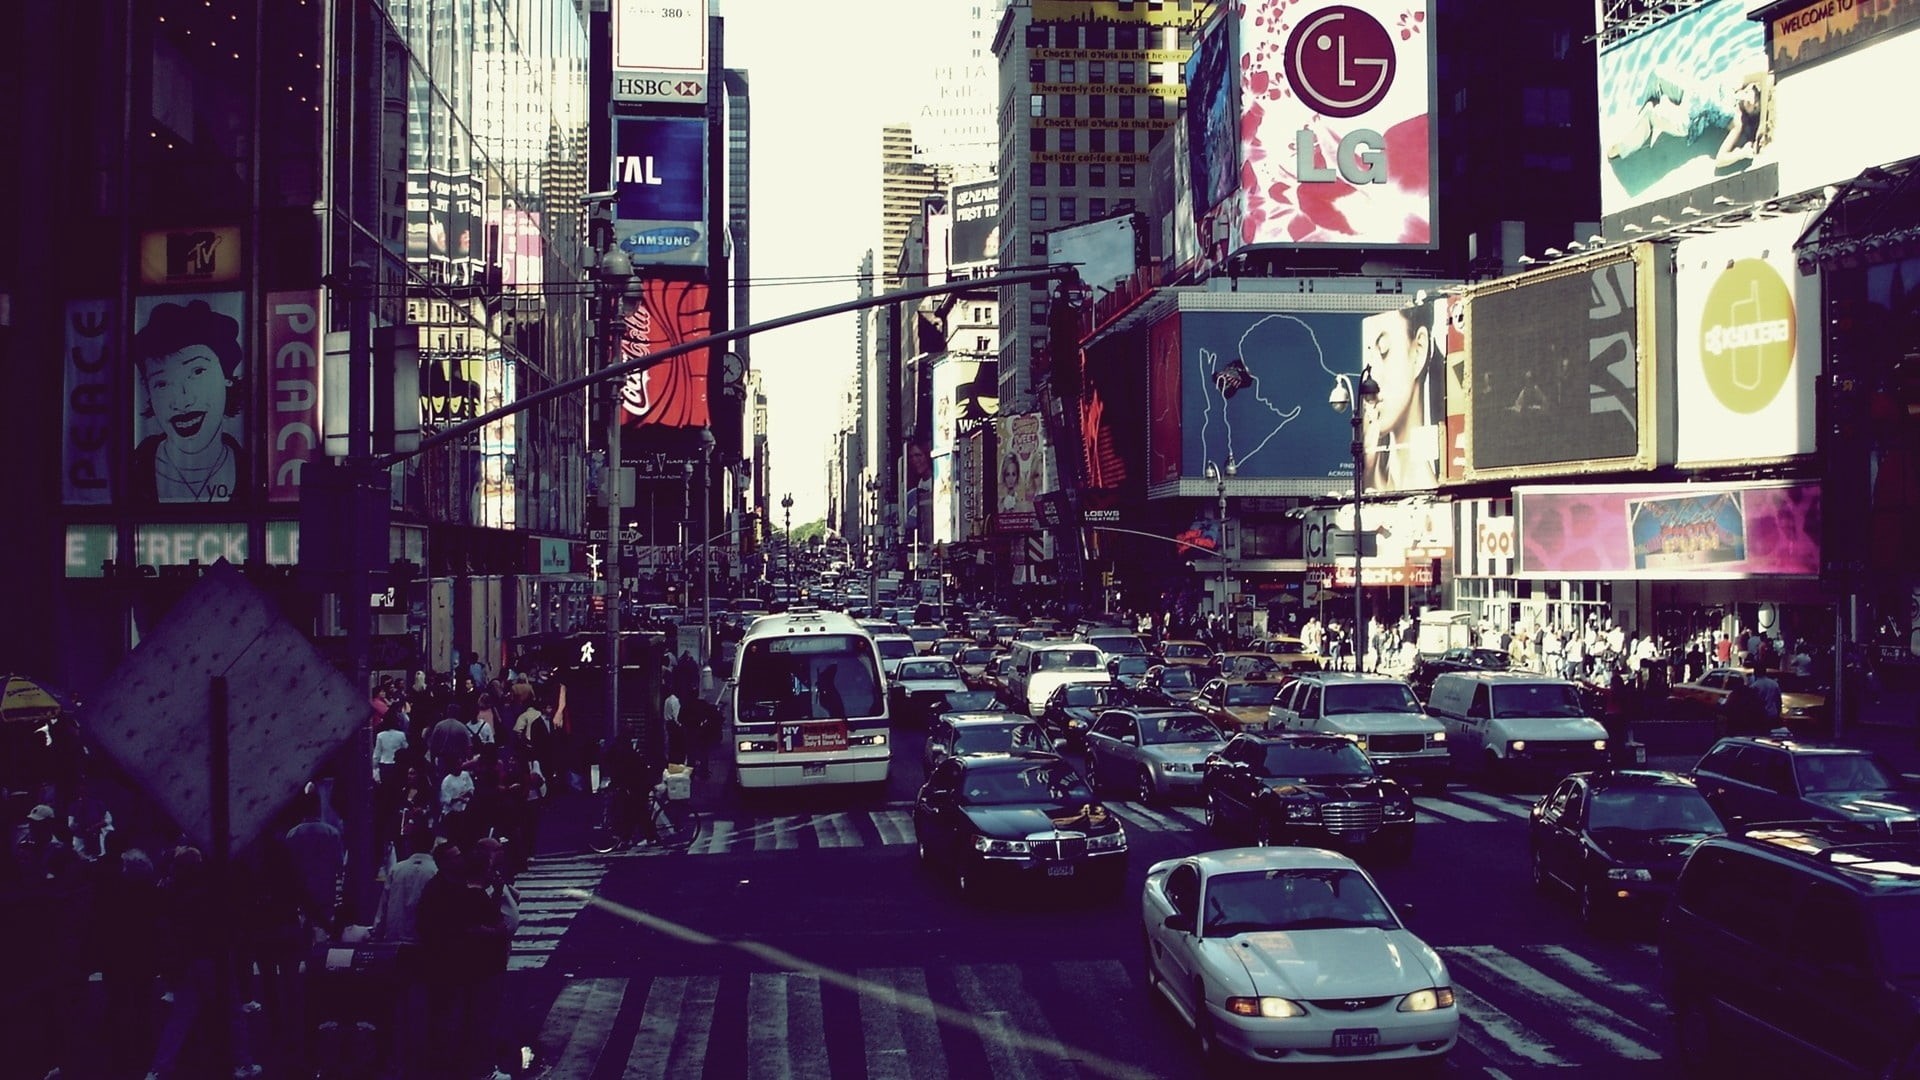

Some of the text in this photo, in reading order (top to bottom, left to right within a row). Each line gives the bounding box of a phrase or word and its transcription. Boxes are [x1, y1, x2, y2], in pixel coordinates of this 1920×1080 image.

[1780, 0, 1854, 36] WELCOME TO
[1043, 50, 1070, 58] Chock
[1073, 50, 1088, 58] full
[1131, 51, 1149, 59] that
[617, 78, 672, 96] HSBC
[1073, 119, 1088, 127] full
[1131, 120, 1149, 128] that
[1296, 128, 1388, 185] LG
[629, 235, 691, 247] SAMSUNG
[166, 231, 222, 275] MTV
[69, 311, 109, 489] PEACE
[275, 303, 317, 486] PEACE
[206, 485, 232, 503] yo.
[594, 531, 639, 541] ON WAY
[1478, 523, 1514, 555] Foo
[570, 582, 585, 593] 44
[371, 586, 395, 608] MTV
[783, 726, 800, 735] NY
[782, 735, 793, 752] 1
